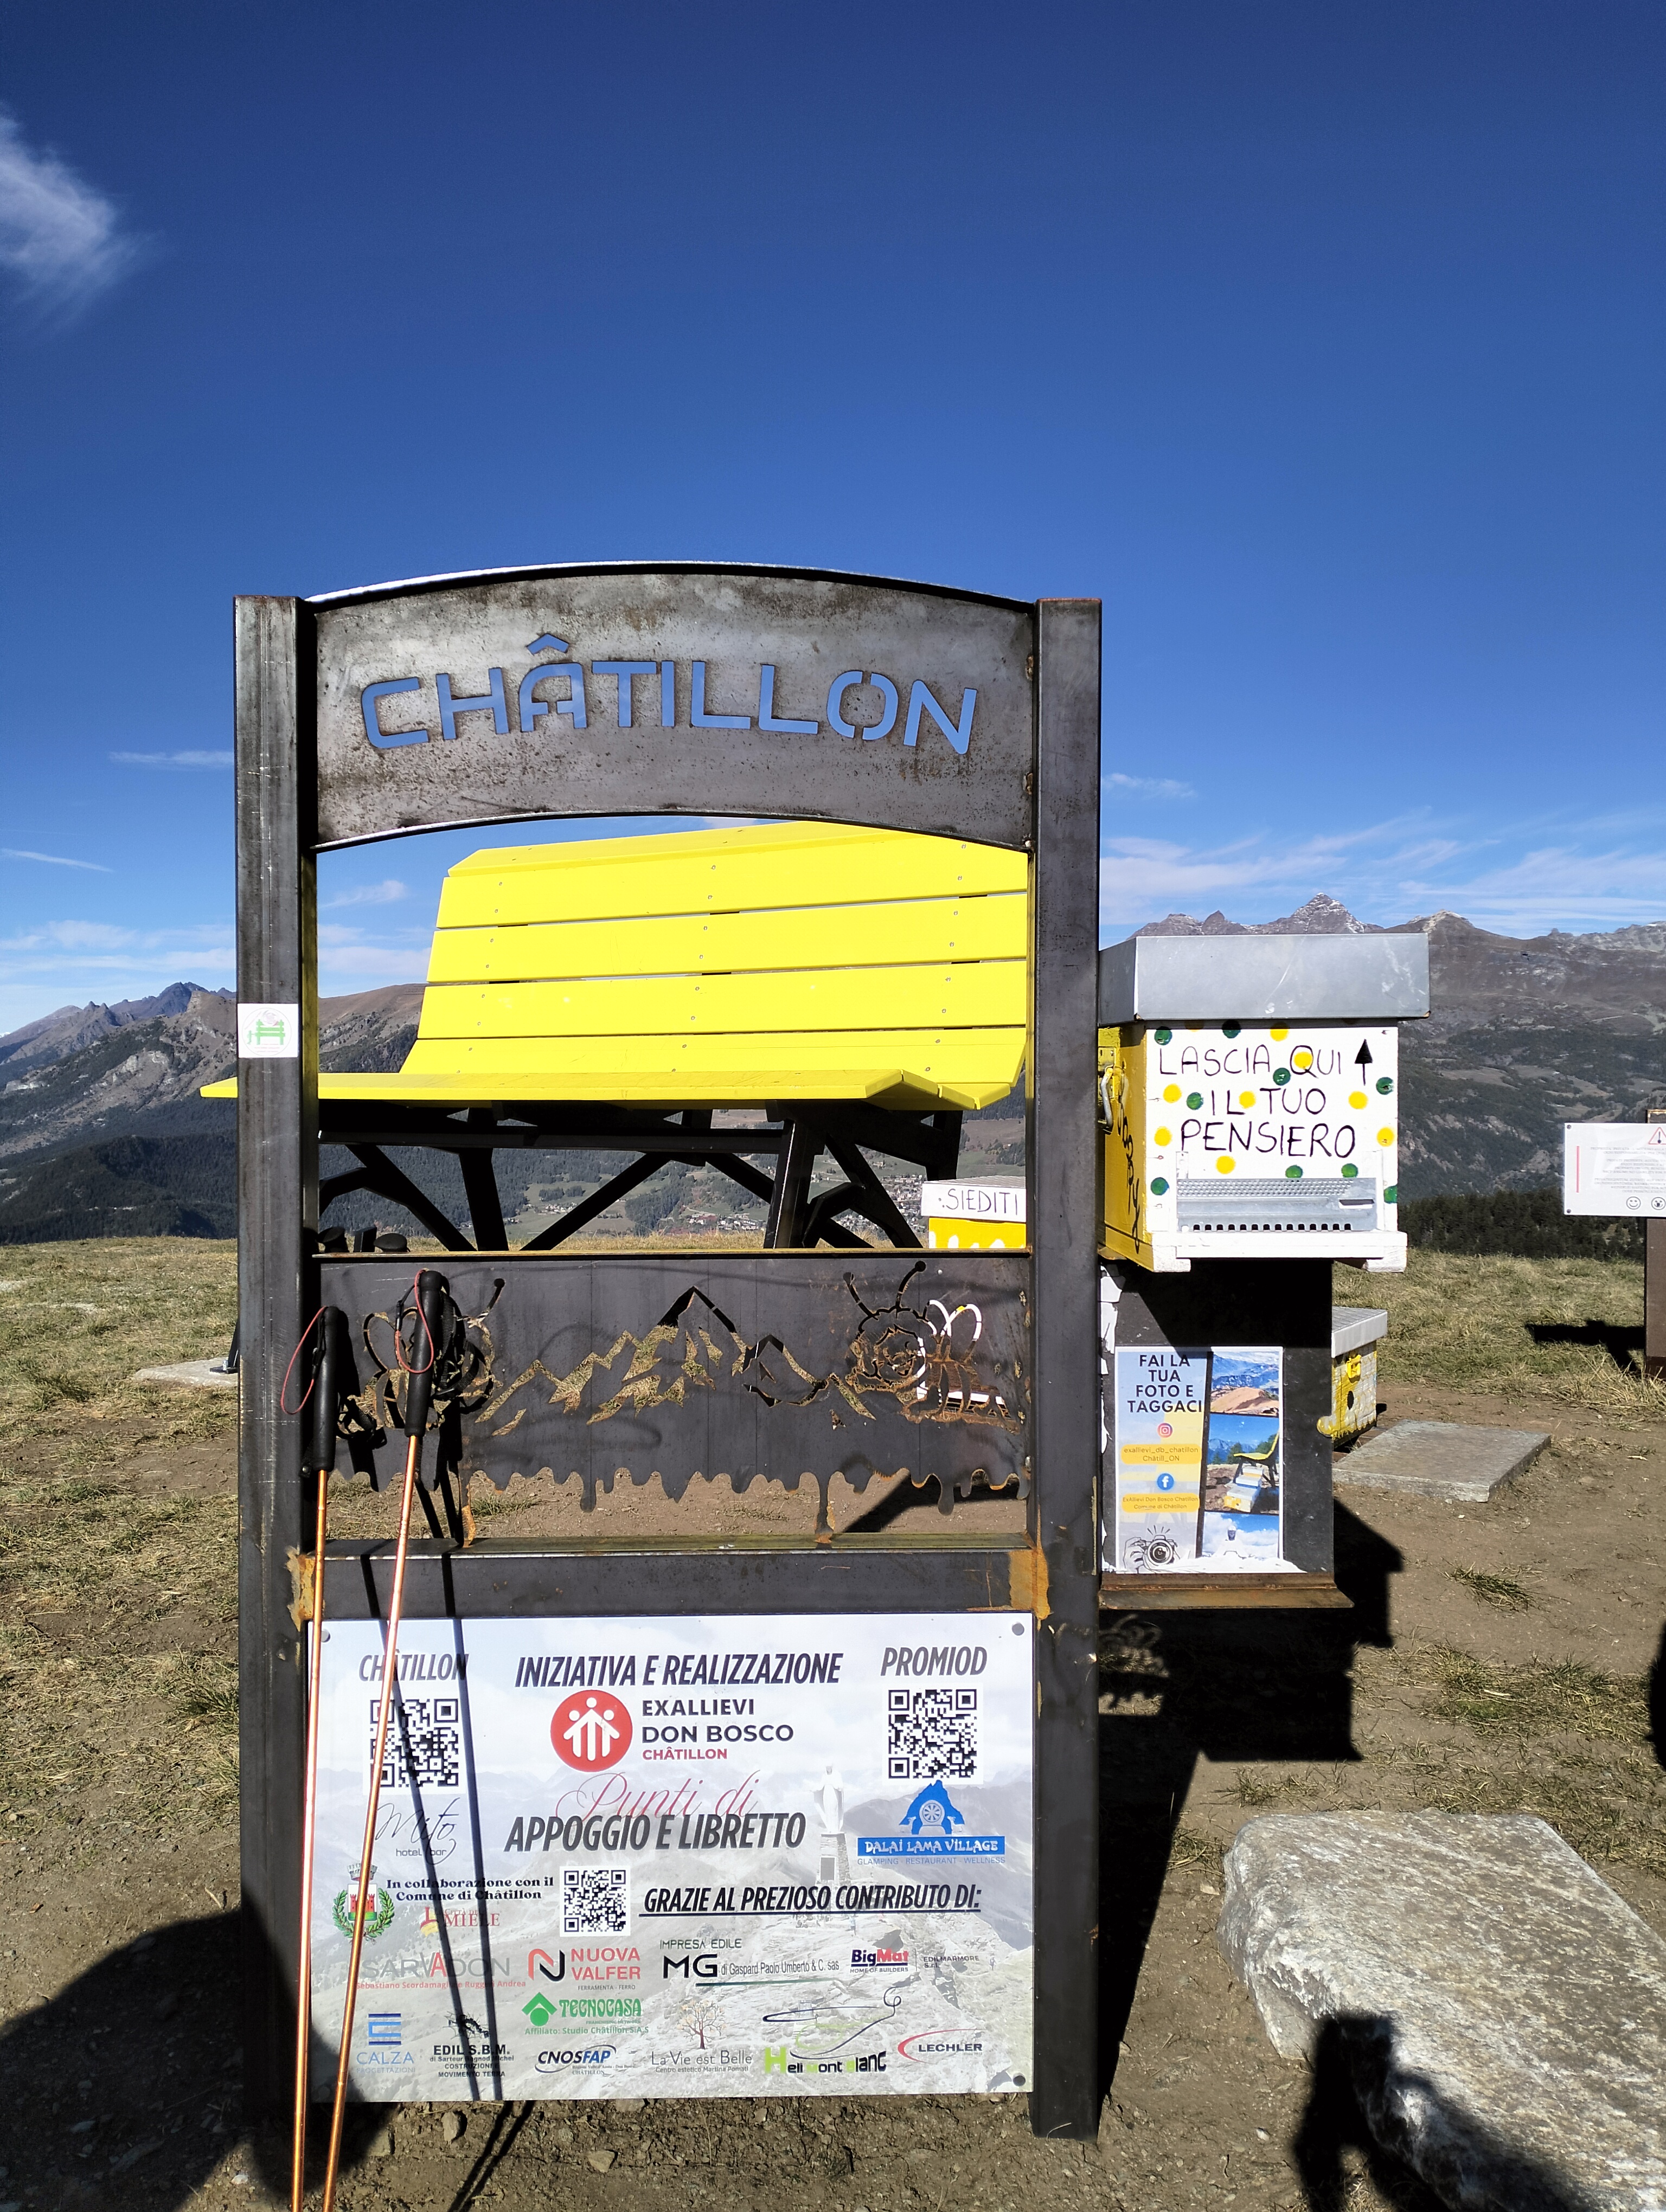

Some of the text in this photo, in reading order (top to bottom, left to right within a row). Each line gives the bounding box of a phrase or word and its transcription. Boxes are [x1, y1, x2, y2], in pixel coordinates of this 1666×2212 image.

[361, 633, 976, 754] CHÂTILLON
[1159, 1045, 1341, 1078] LASCIA QUI
[1212, 1088, 1325, 1115] IL TUO
[1180, 1119, 1355, 1158] PENSIERO
[946, 1188, 1017, 1216] SIEDITI
[1139, 1354, 1190, 1367] FAI LA
[1148, 1369, 1181, 1382] TUA
[1136, 1385, 1193, 1397] FOTO E
[1127, 1400, 1202, 1412] TAGGACI
[880, 1646, 988, 1676] PROMIOD
[514, 1652, 844, 1687] INIZIATIVA E REALIZZAZIONE
[642, 1698, 754, 1716] EXALLIEVI
[642, 1724, 794, 1743] DON BOSCO
[642, 1746, 728, 1761] CHÂTILLON
[556, 1770, 760, 1827] Punti di
[504, 1812, 806, 1853] APPOGGIO E LIBRETTO
[395, 1848, 447, 1857] hotel bar
[906, 1840, 943, 1854] LAMA
[945, 1838, 998, 1854] VILLAGE
[387, 1879, 401, 1889] In
[405, 1877, 512, 1889] collaborazione
[544, 1876, 554, 1886] il
[396, 1889, 542, 1901] Comune di Châtillon
[644, 1884, 982, 1912] GRAZIE AL PREZIOSO CONTRIBUTO DI:
[444, 1913, 500, 1927] MIELE
[660, 1939, 742, 1950] IMPRESA EDILE
[571, 1947, 640, 1962] NUOVA
[851, 1948, 909, 1965] BigMat
[362, 1952, 510, 1978] SARVADON
[663, 1953, 840, 1979] MG di Gaspard Paolo Umberto & C. sas
[571, 1966, 641, 1980] VALFER
[356, 1981, 400, 1989] Sebastiano
[559, 1998, 642, 2017] TECNOCASA
[433, 2045, 464, 2055] EDIL
[918, 2043, 983, 2052] LECHLER
[356, 2052, 414, 2065] CALZA
[538, 2050, 611, 2065] CNOSFAP
[651, 2050, 752, 2065] La Vie est Belle
[765, 2047, 803, 2074] Heli
